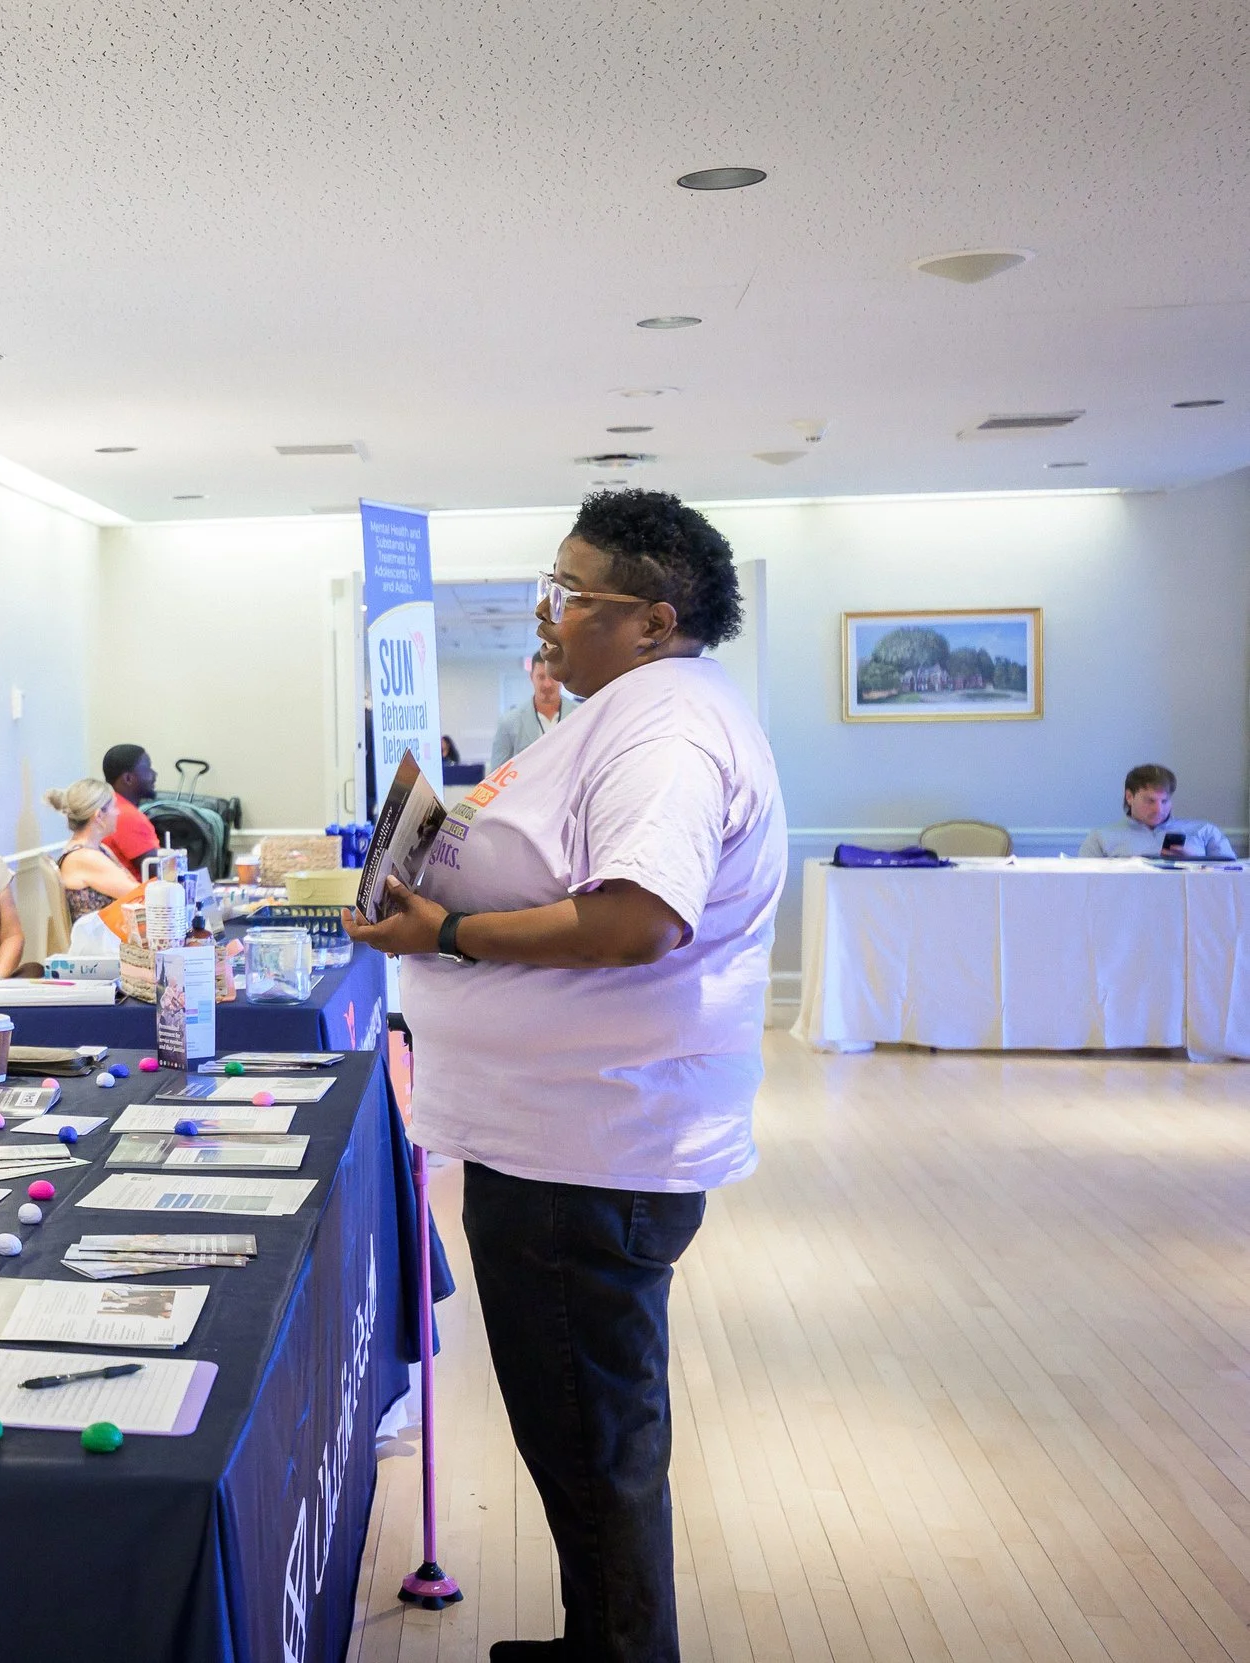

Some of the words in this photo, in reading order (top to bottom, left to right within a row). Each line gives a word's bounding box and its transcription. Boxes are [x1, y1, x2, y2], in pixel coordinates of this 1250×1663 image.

[370, 521, 390, 533] Mental
[390, 523, 409, 537] Health
[410, 528, 421, 539] and
[405, 541, 416, 552] Use
[379, 638, 414, 697] SUN
[381, 701, 428, 732] Behavioral
